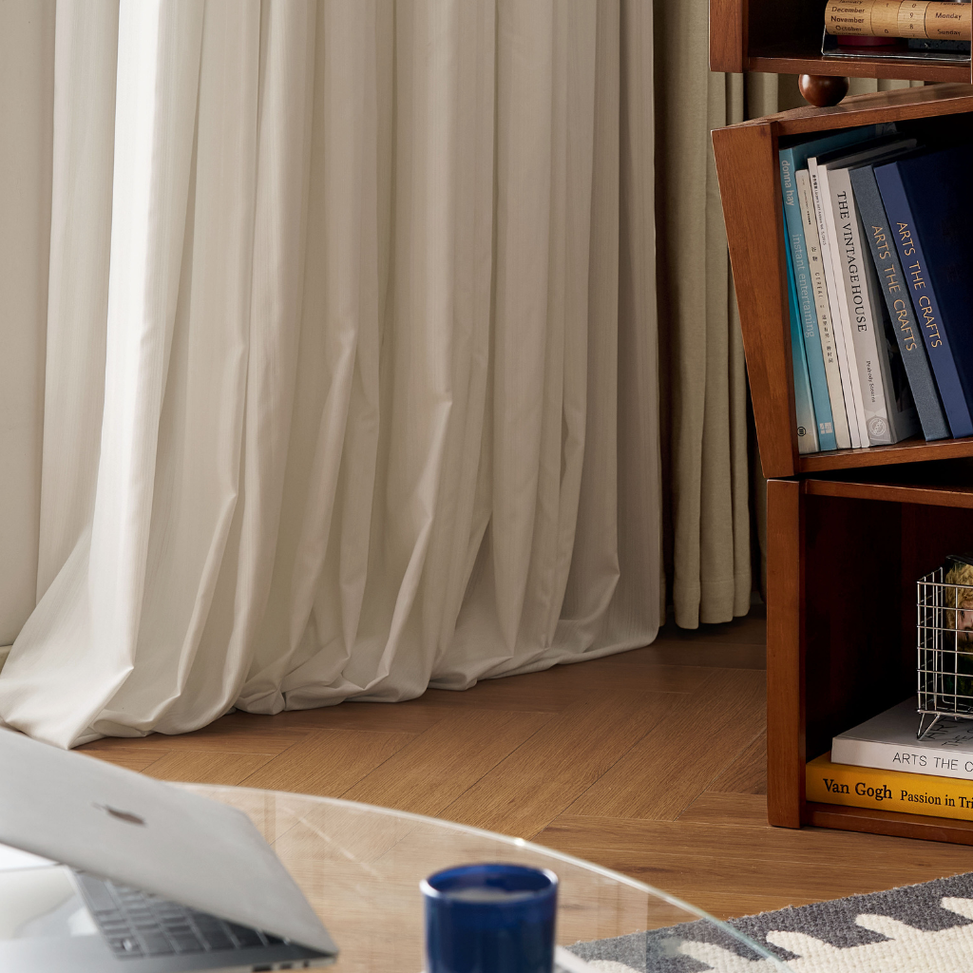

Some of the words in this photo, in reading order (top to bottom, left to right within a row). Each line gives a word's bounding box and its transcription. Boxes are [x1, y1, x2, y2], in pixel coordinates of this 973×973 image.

[830, 15, 865, 23] November
[935, 12, 962, 20] Monday
[781, 160, 792, 188] donna
[785, 189, 795, 206] hay
[837, 190, 848, 220] THE
[842, 223, 859, 284] VINTAGE
[792, 234, 805, 271] instant
[799, 273, 816, 338] entertaining
[872, 224, 891, 260] ARTS
[884, 264, 901, 294] THE
[893, 298, 918, 352] CRAFTS
[897, 221, 916, 256] ARTS
[909, 260, 926, 291] THE
[918, 294, 943, 349] CRAFTS
[852, 285, 867, 333] HOUSE
[892, 752, 927, 767] ARTS
[934, 757, 959, 770] THE
[822, 778, 850, 795] Van
[855, 782, 893, 800] Gogh
[900, 790, 941, 806] Passion
[945, 794, 956, 807] in
